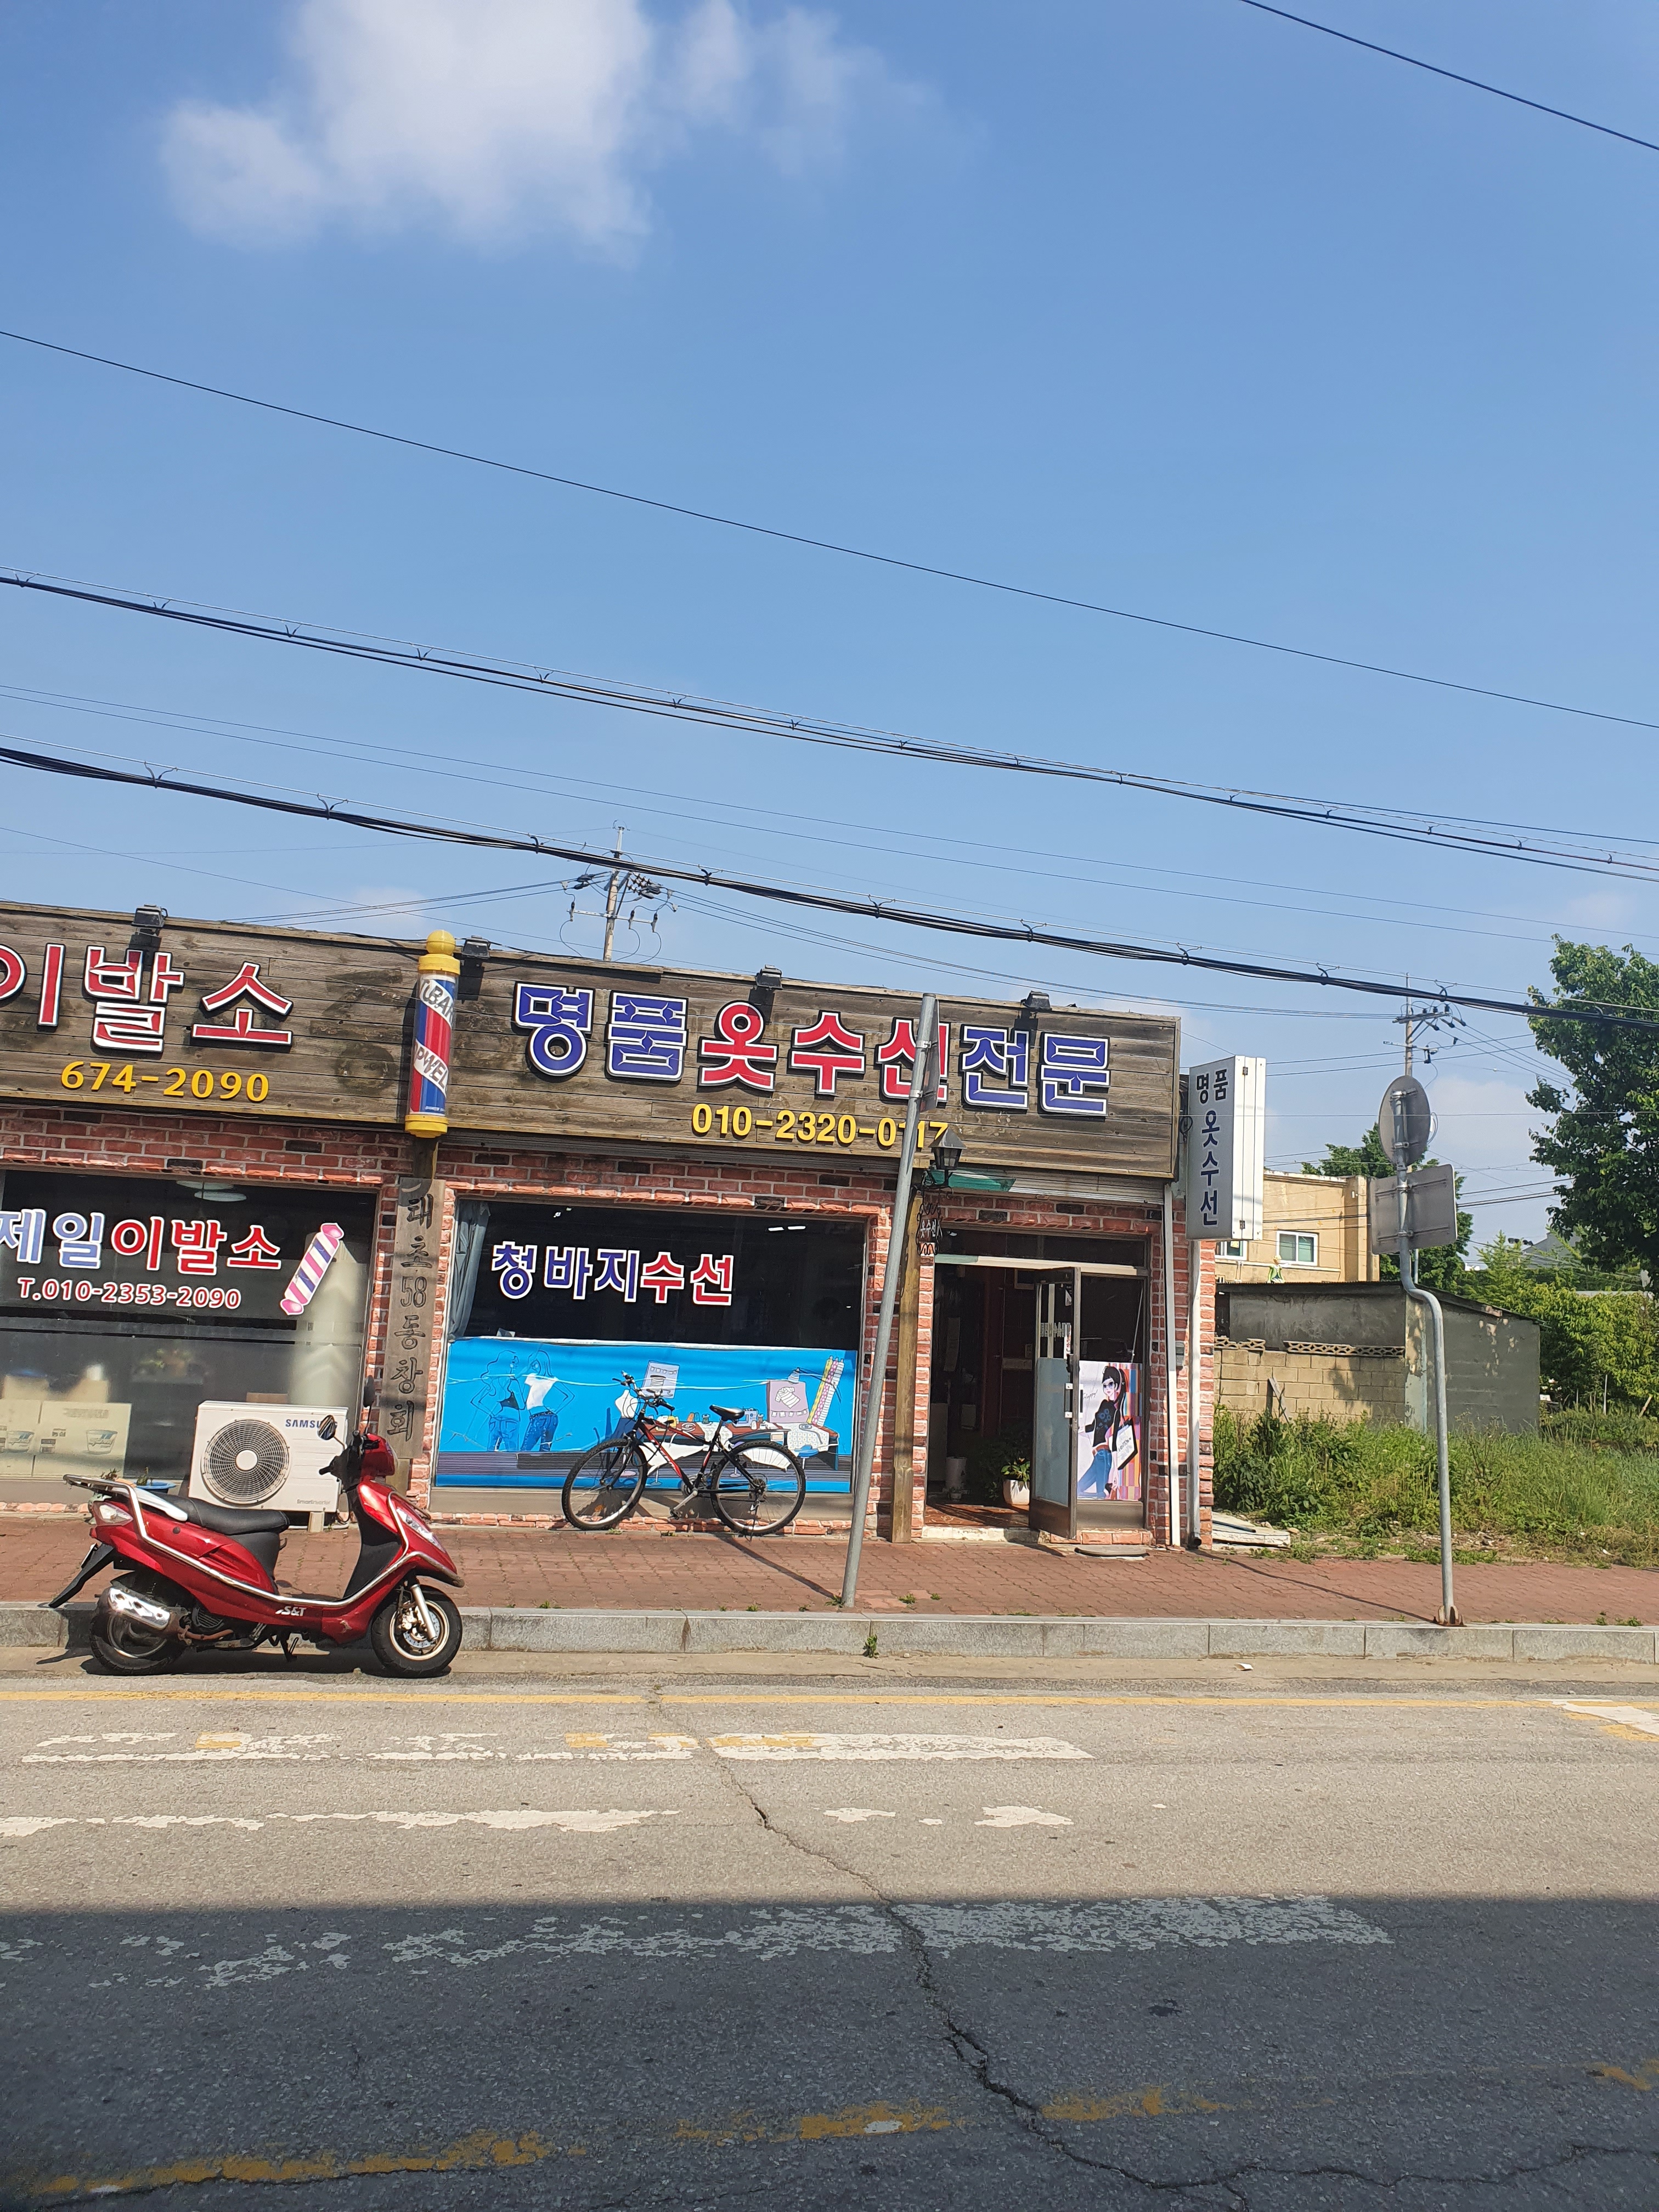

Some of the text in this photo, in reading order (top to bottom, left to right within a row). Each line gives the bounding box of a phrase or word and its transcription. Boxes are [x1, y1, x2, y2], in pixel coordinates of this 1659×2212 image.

[60, 1061, 269, 1103] 674-2090
[1196, 1068, 1228, 1104] 명품
[692, 1103, 949, 1148] 010-2320-017
[1200, 1109, 1221, 1226] 옷수선
[0, 1209, 281, 1276] 제일이발소
[920, 1218, 936, 1238] 옷수선
[492, 1241, 734, 1306] 청바지수선
[17, 1277, 242, 1310] T.010-2353-2090
[285, 1419, 338, 1429] SAMS
[280, 1606, 307, 1617] S&T
